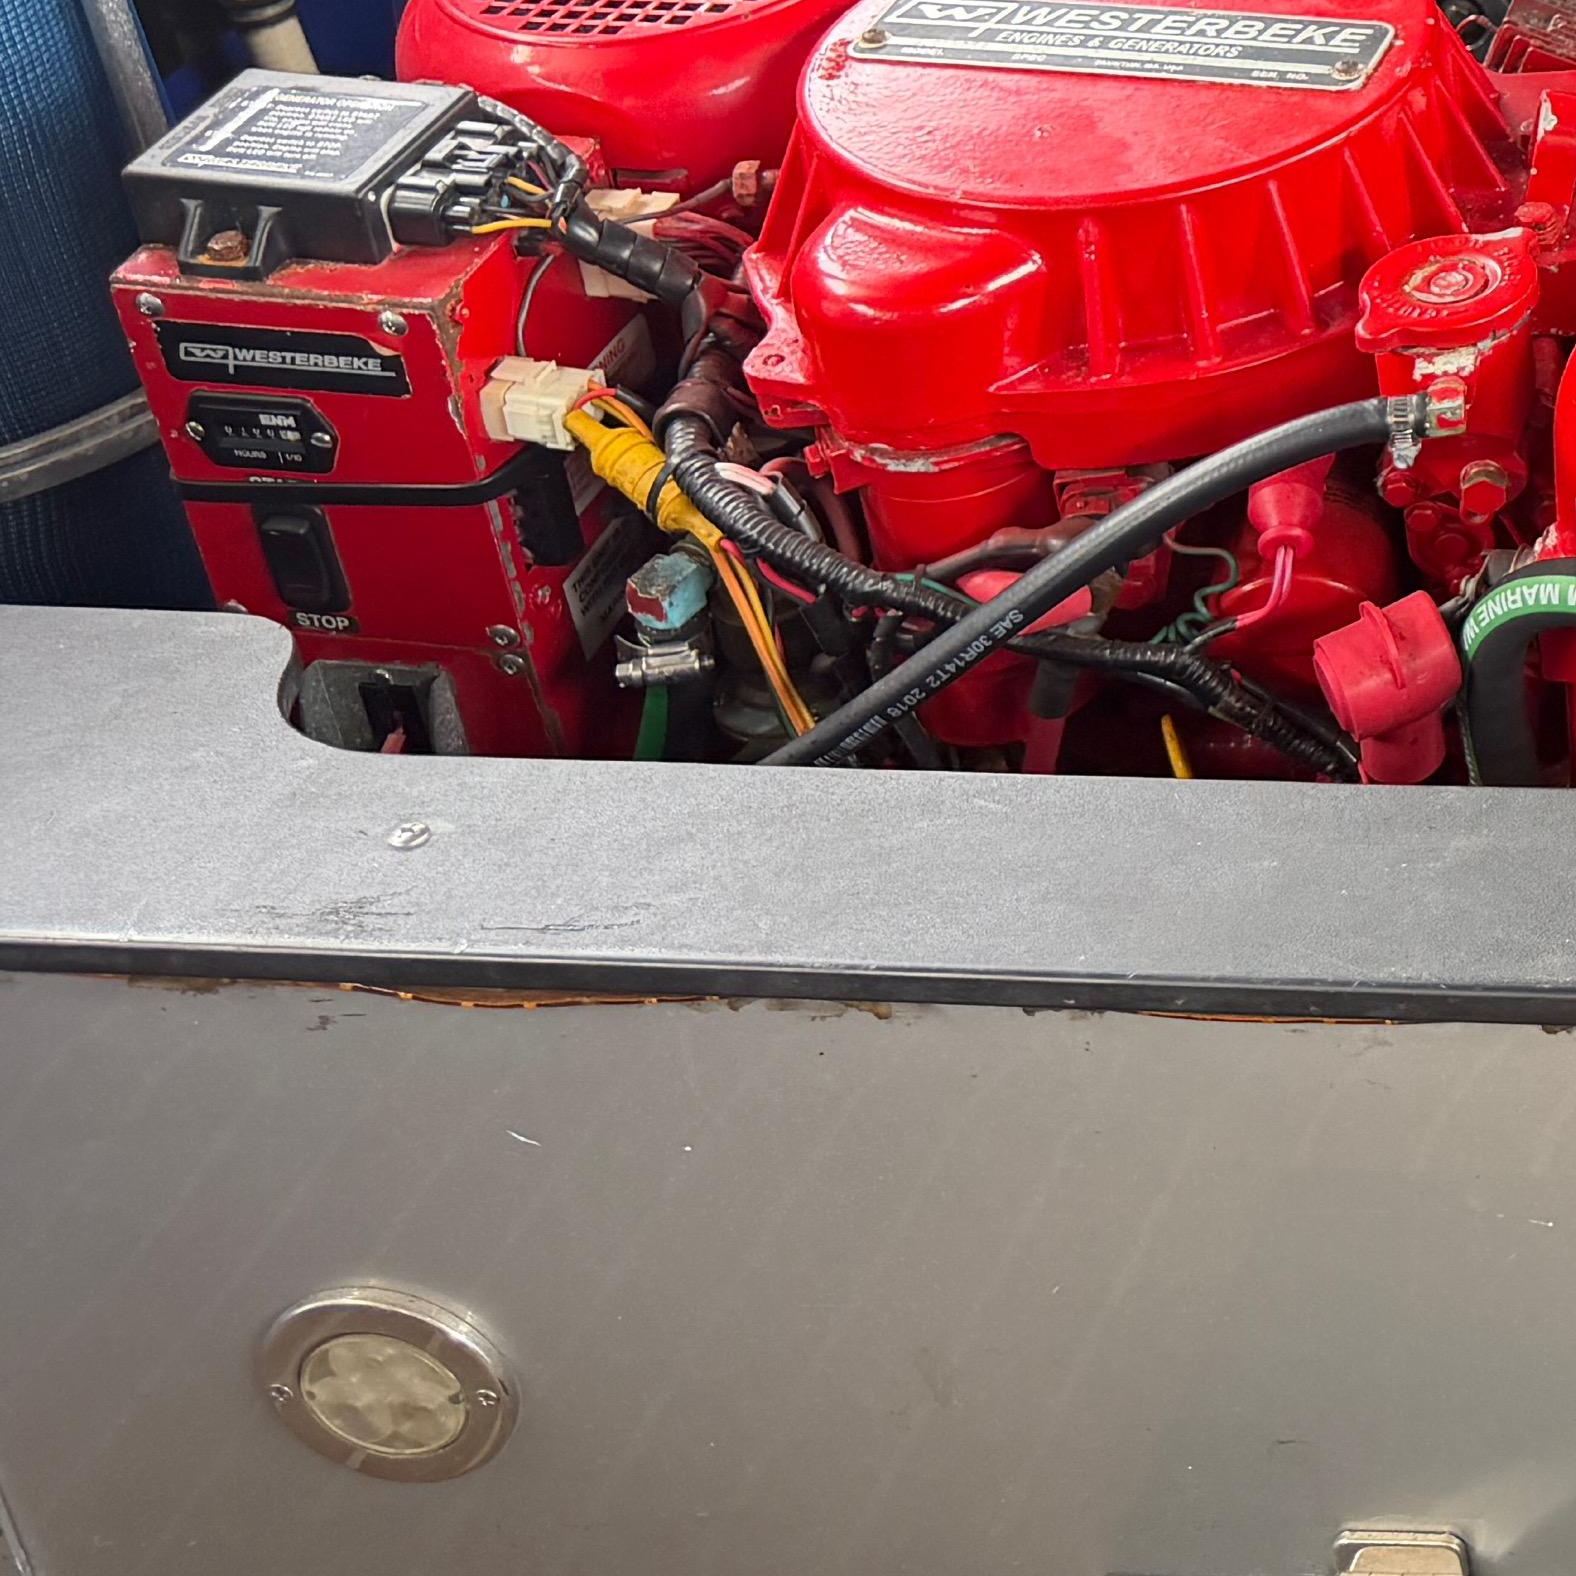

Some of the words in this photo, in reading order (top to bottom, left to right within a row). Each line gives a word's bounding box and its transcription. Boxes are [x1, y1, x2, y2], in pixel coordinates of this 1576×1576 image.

[1013, 5, 1376, 49] WESTERBEKE
[997, 31, 1085, 47] ENGINES
[1088, 36, 1099, 48] &
[1109, 38, 1243, 58] GENERATORS
[234, 348, 382, 372] WESTERBEKE
[1476, 583, 1560, 627] MARINE
[295, 612, 350, 630] STOP
[995, 608, 1024, 639] SAE
[925, 634, 993, 689] 30R14T2
[887, 687, 926, 718] 2018
